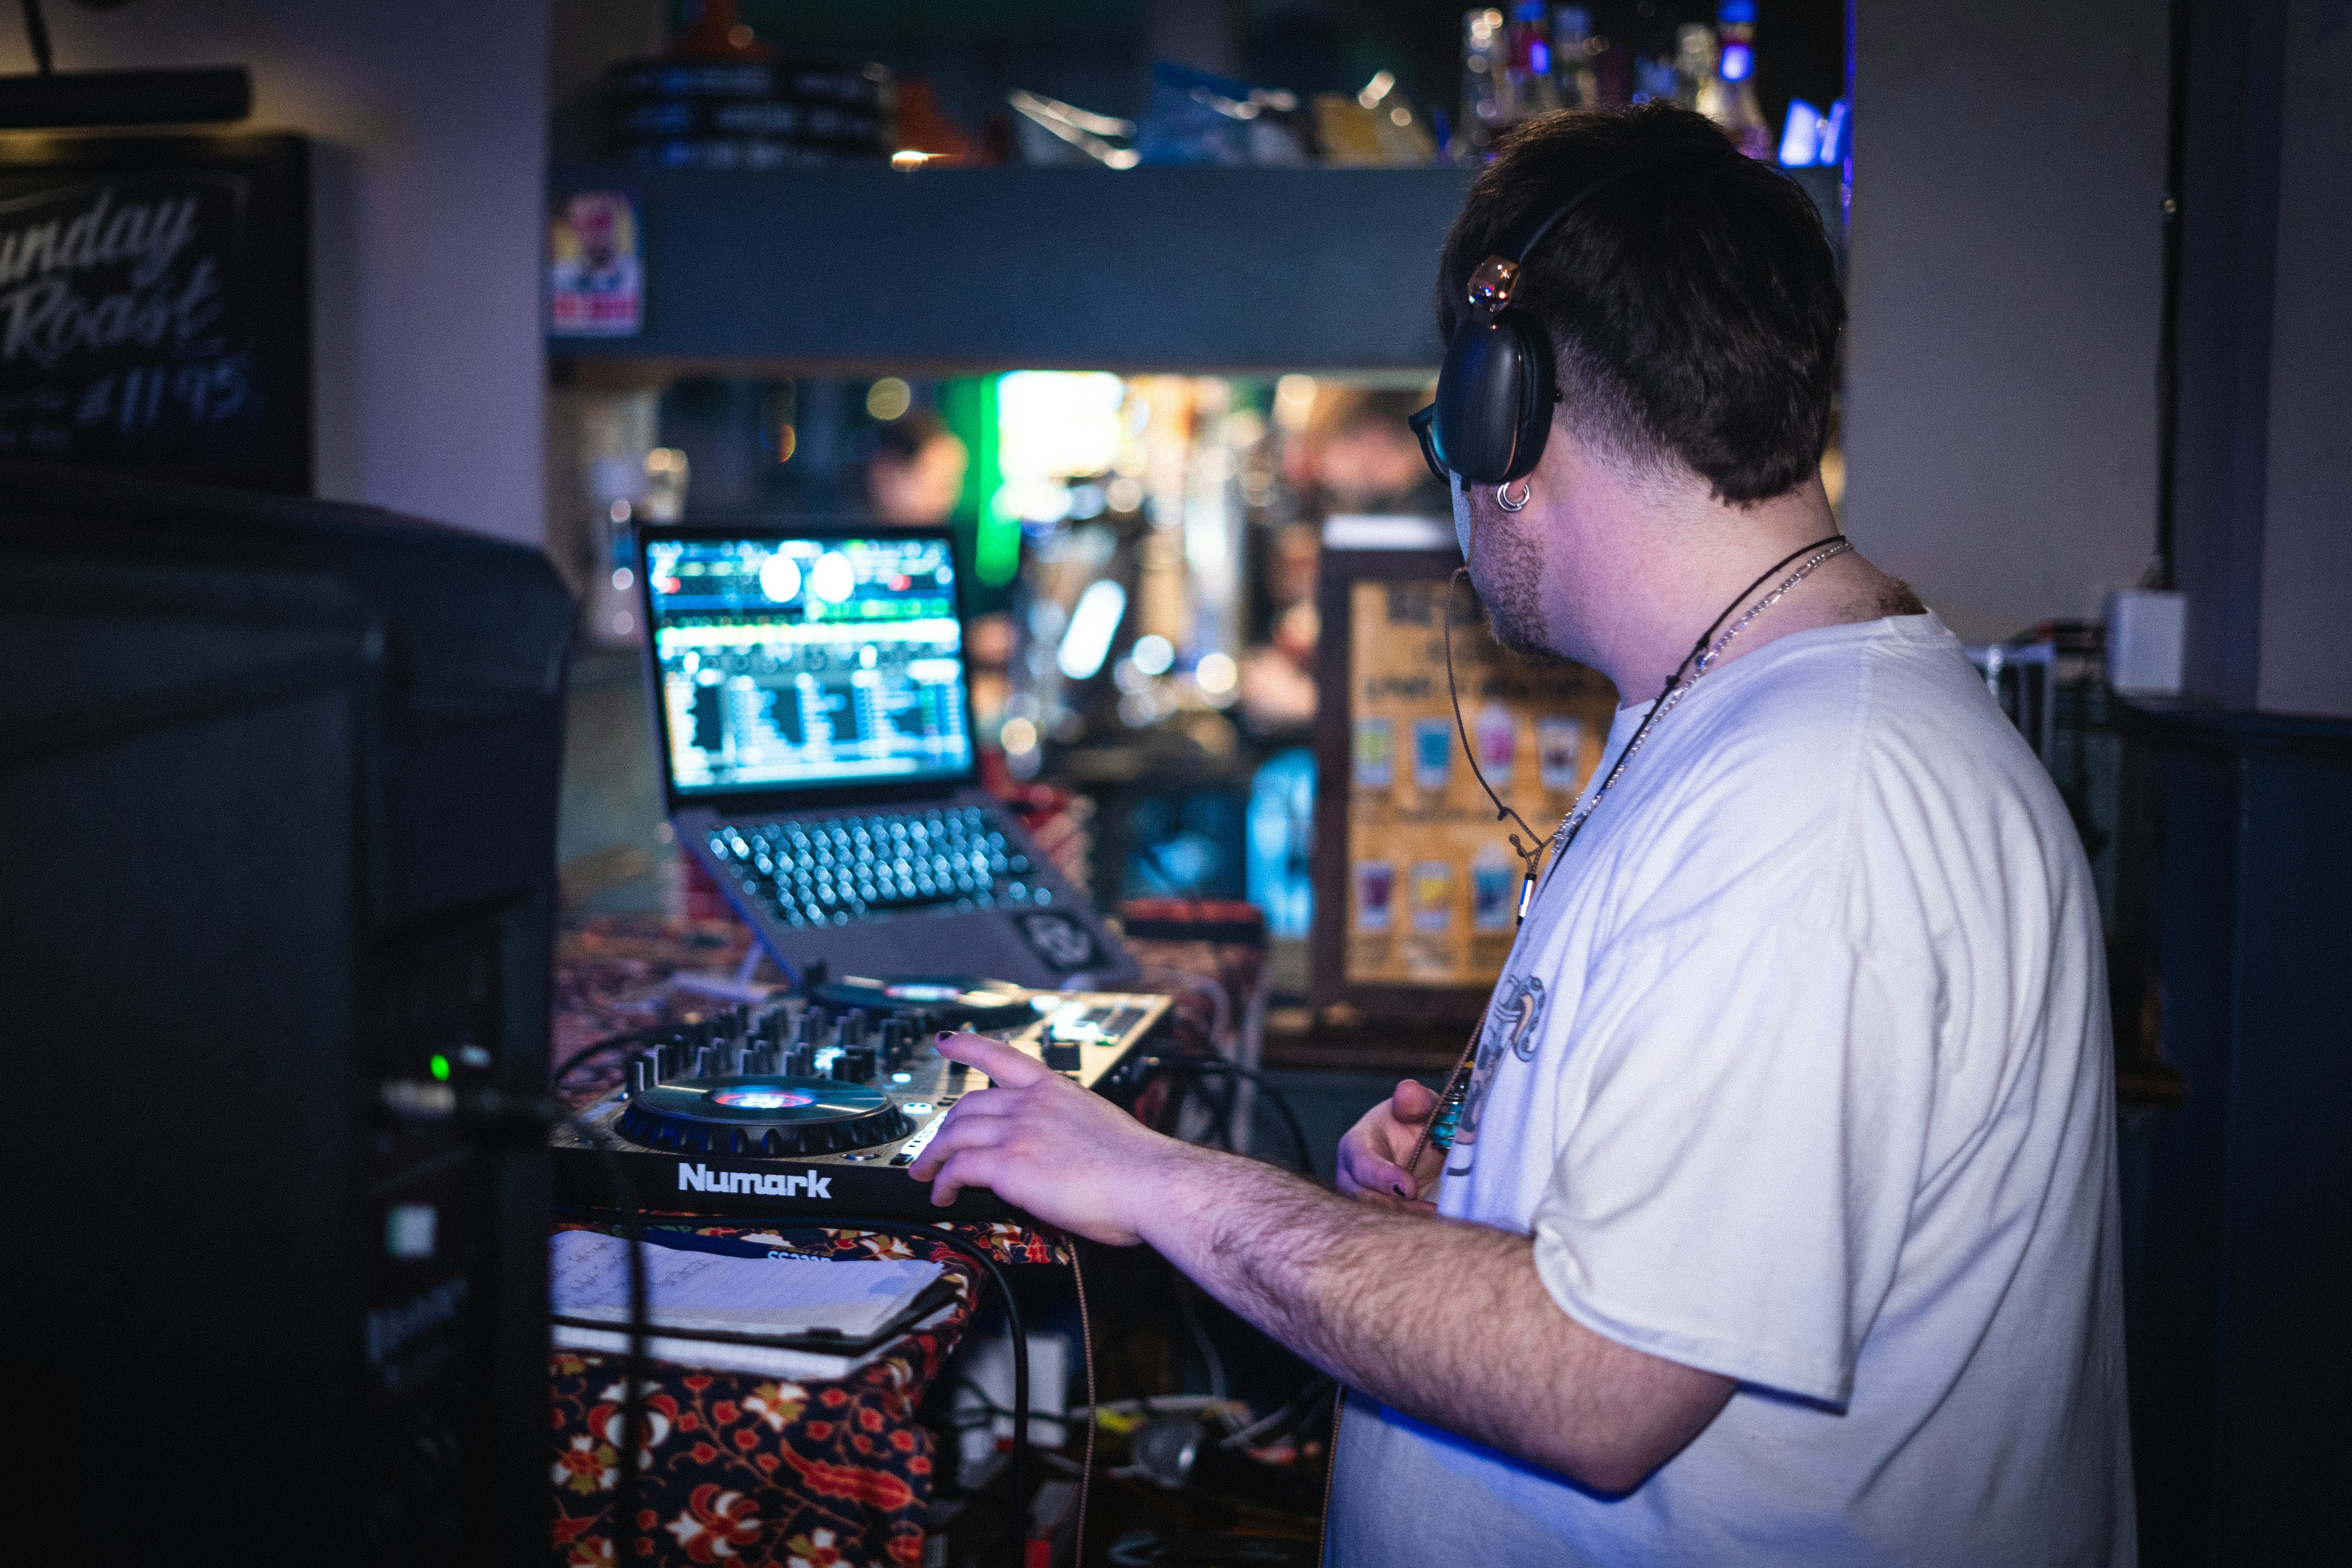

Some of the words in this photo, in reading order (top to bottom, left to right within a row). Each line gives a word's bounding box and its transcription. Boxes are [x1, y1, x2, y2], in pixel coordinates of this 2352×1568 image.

[0, 189, 197, 287] unday
[0, 256, 227, 368] Roast
[678, 1163, 832, 1198] Numark
